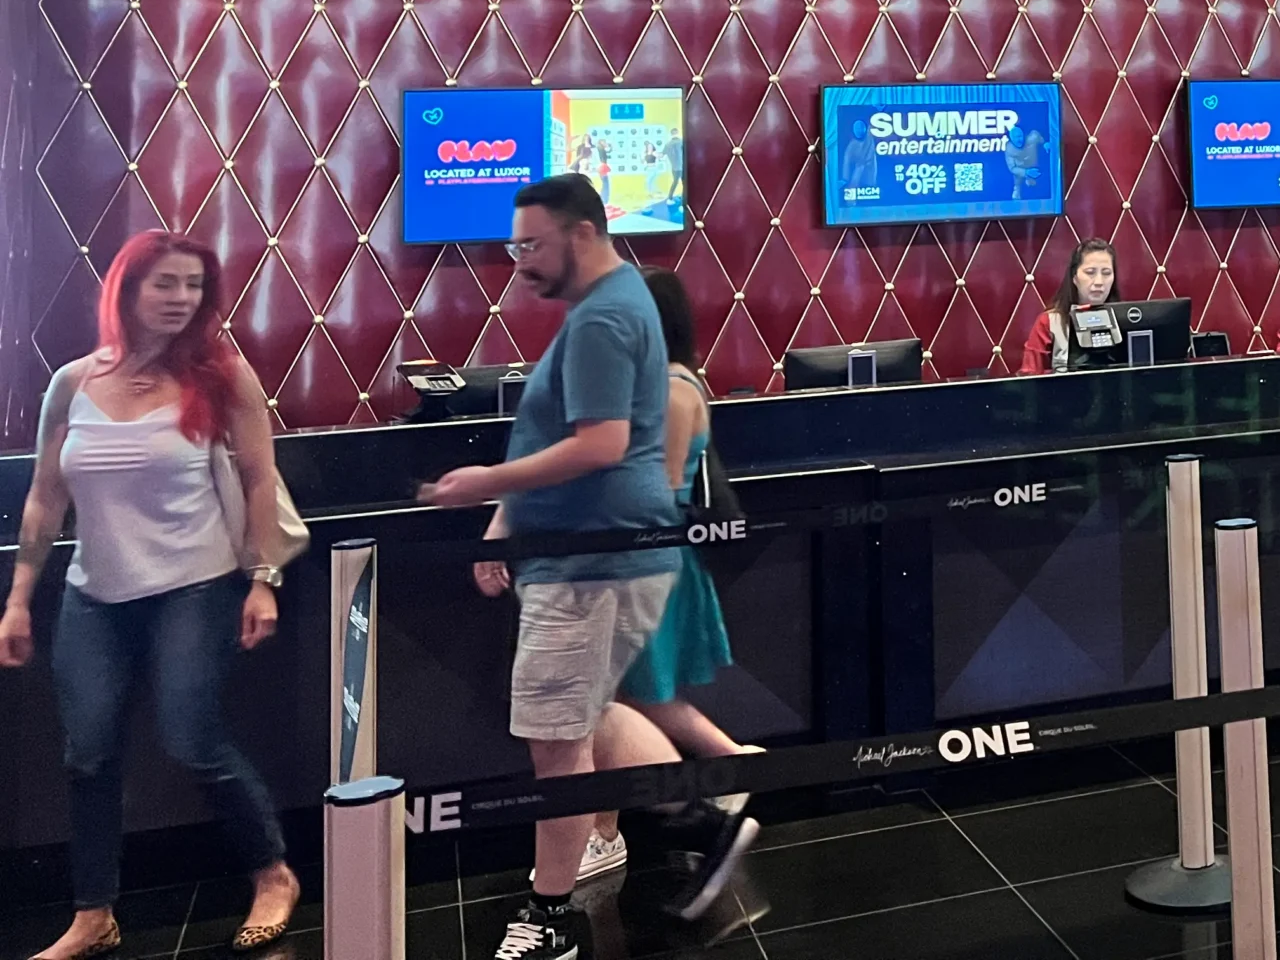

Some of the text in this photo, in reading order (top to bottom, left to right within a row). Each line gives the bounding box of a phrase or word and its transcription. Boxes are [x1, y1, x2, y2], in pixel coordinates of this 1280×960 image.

[869, 109, 1019, 138] SUMMER
[875, 135, 1010, 156] entertainment
[1206, 145, 1280, 155] LOCATED AT LUXOR
[424, 167, 531, 179] LOCATED AT LUXOR
[906, 163, 947, 179] 40%
[857, 187, 880, 196] MGM
[905, 177, 947, 195] OFF
[994, 483, 1047, 507] ONE
[687, 519, 747, 544] ONE
[938, 721, 1035, 762] ONE
[404, 792, 463, 834] NE
